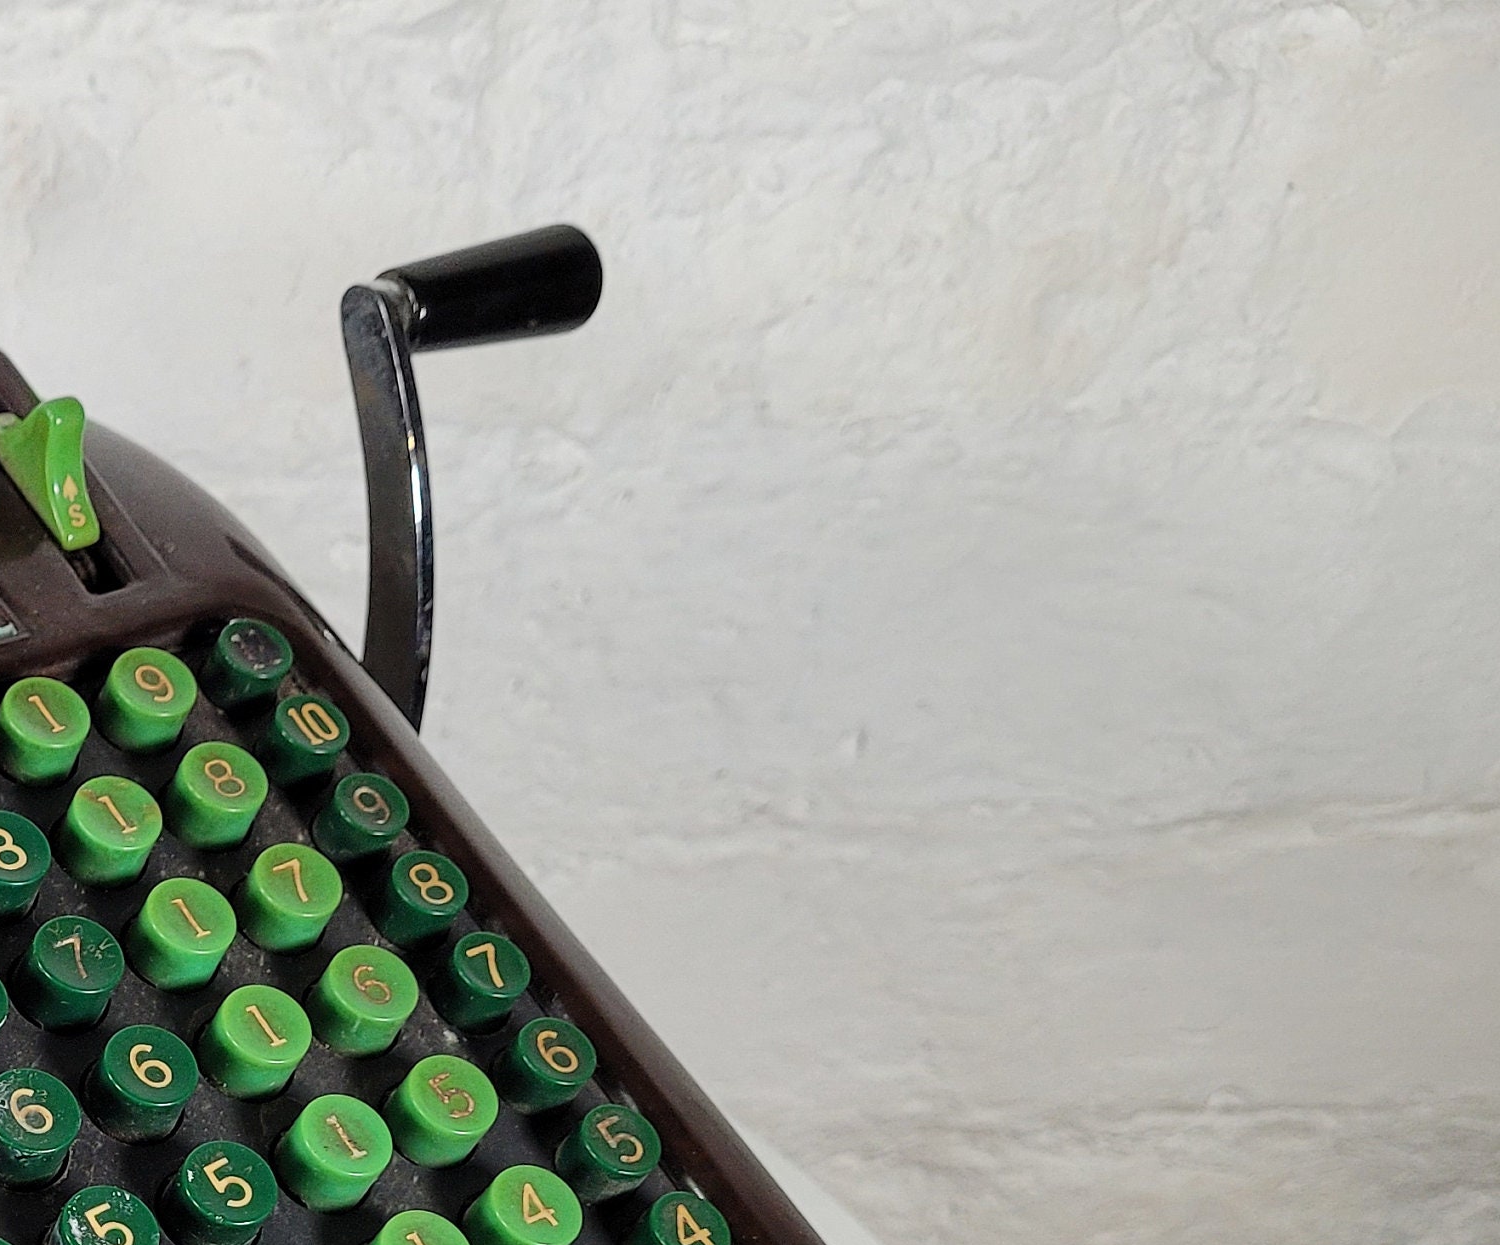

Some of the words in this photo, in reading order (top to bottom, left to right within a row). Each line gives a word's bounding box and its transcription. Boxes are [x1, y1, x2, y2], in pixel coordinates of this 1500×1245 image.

[68, 504, 86, 527] S
[134, 665, 174, 703] 9
[28, 695, 65, 733] 1
[288, 704, 340, 746] 10
[204, 760, 245, 797] 8
[99, 796, 138, 835] 1
[353, 786, 390, 825] 9
[273, 858, 309, 903] 7
[409, 862, 454, 905] 8
[171, 899, 211, 938] 1
[53, 934, 88, 979] 7
[466, 942, 504, 988] 7
[352, 966, 392, 1004] 6
[246, 1005, 287, 1047] 1
[129, 1044, 173, 1088] 6
[536, 1030, 579, 1074] 6
[9, 1088, 53, 1134] 6
[429, 1073, 475, 1119] 5
[326, 1115, 368, 1160] 1
[596, 1116, 644, 1163] 5
[203, 1157, 252, 1208] 5
[521, 1183, 558, 1227] 4
